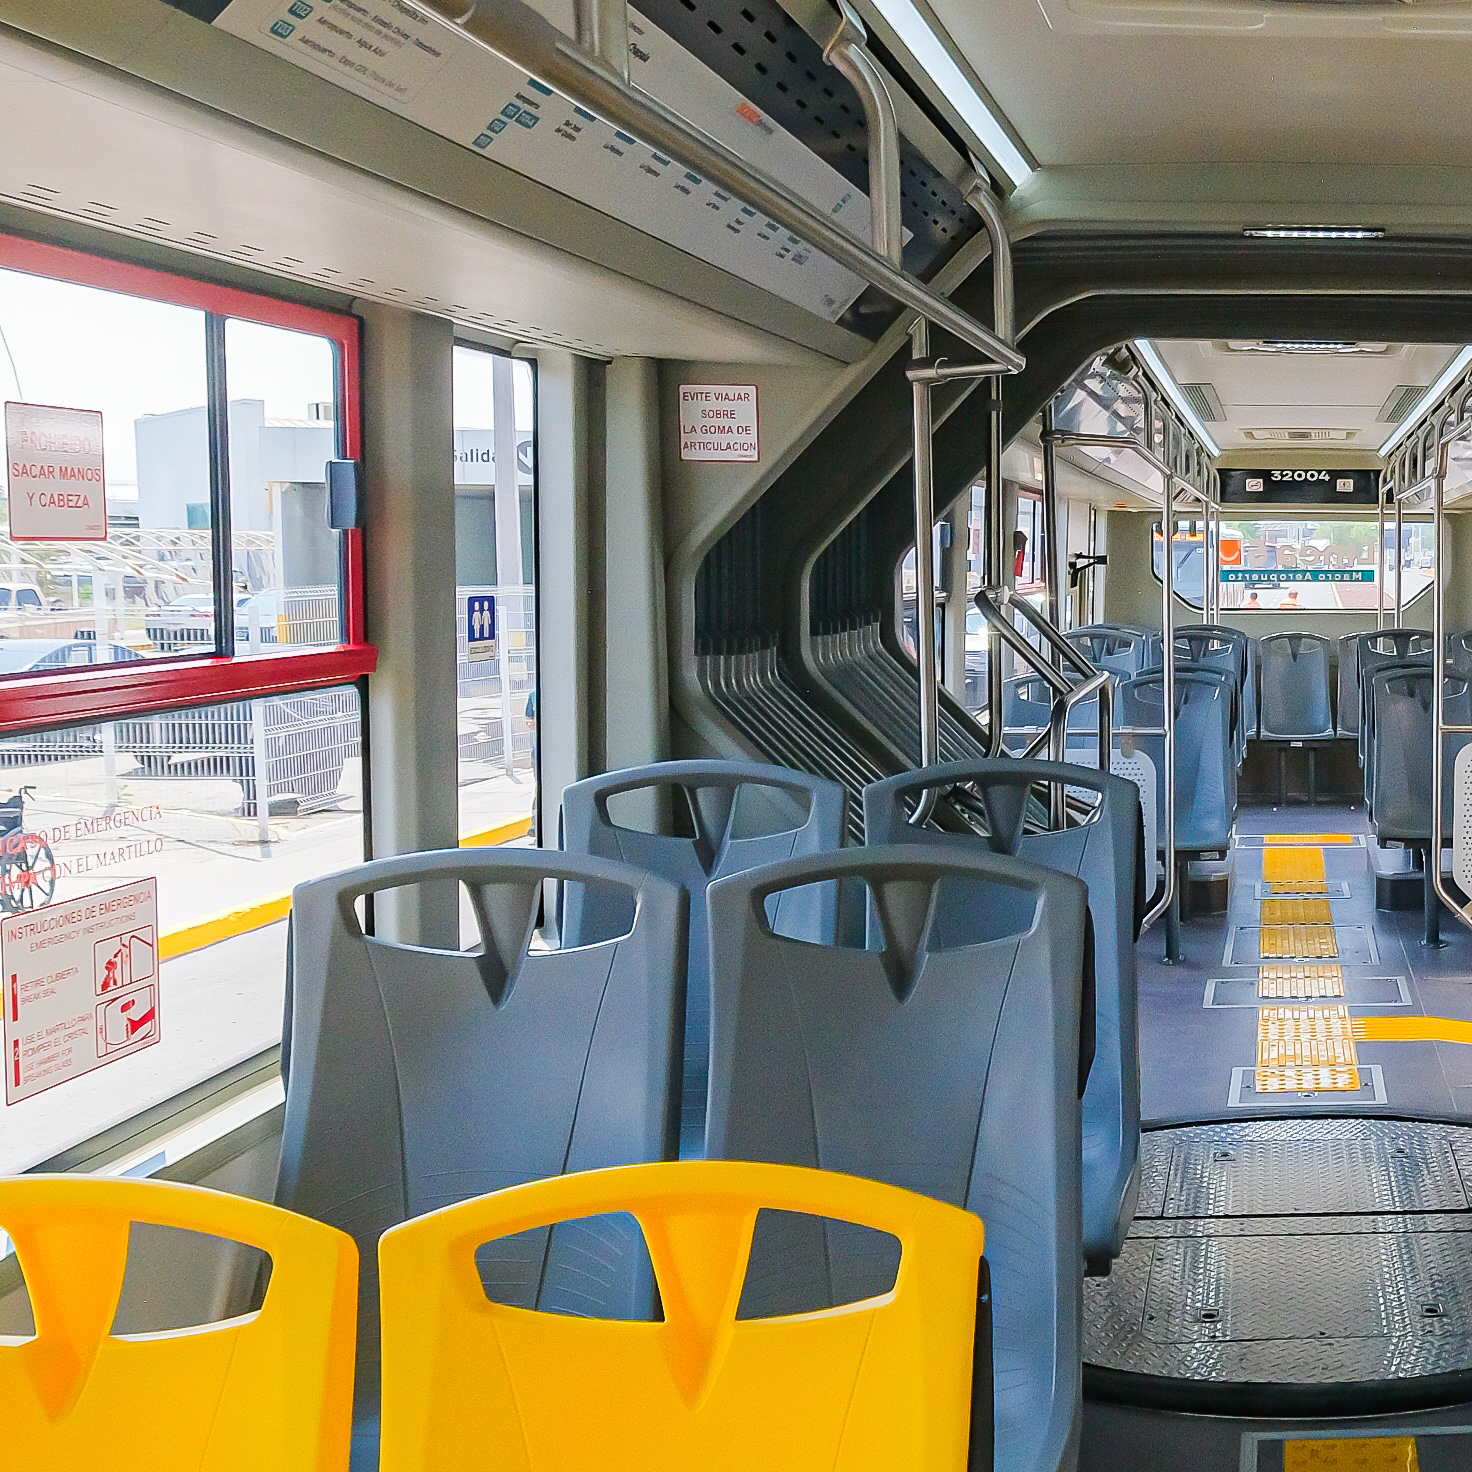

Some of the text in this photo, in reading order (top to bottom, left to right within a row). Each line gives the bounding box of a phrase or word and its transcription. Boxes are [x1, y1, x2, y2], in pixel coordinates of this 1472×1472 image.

[683, 392, 750, 402] EVITE VIAJAR
[701, 409, 736, 420] SOBRE
[683, 425, 751, 435] LA GOMA DE
[12, 462, 101, 482] SACAR MANOS
[1270, 470, 1331, 482] 32004
[27, 492, 90, 508] Y CABEZA
[52, 825, 71, 843] DE
[75, 805, 163, 838] EMERGENCIA
[77, 854, 94, 874] EL
[96, 838, 163, 867] MARTILLO
[7, 890, 153, 943] INSTRUCCIONES DE EMERGENCIA
[30, 912, 136, 953] EMERGENCY INSTRUCTIONS
